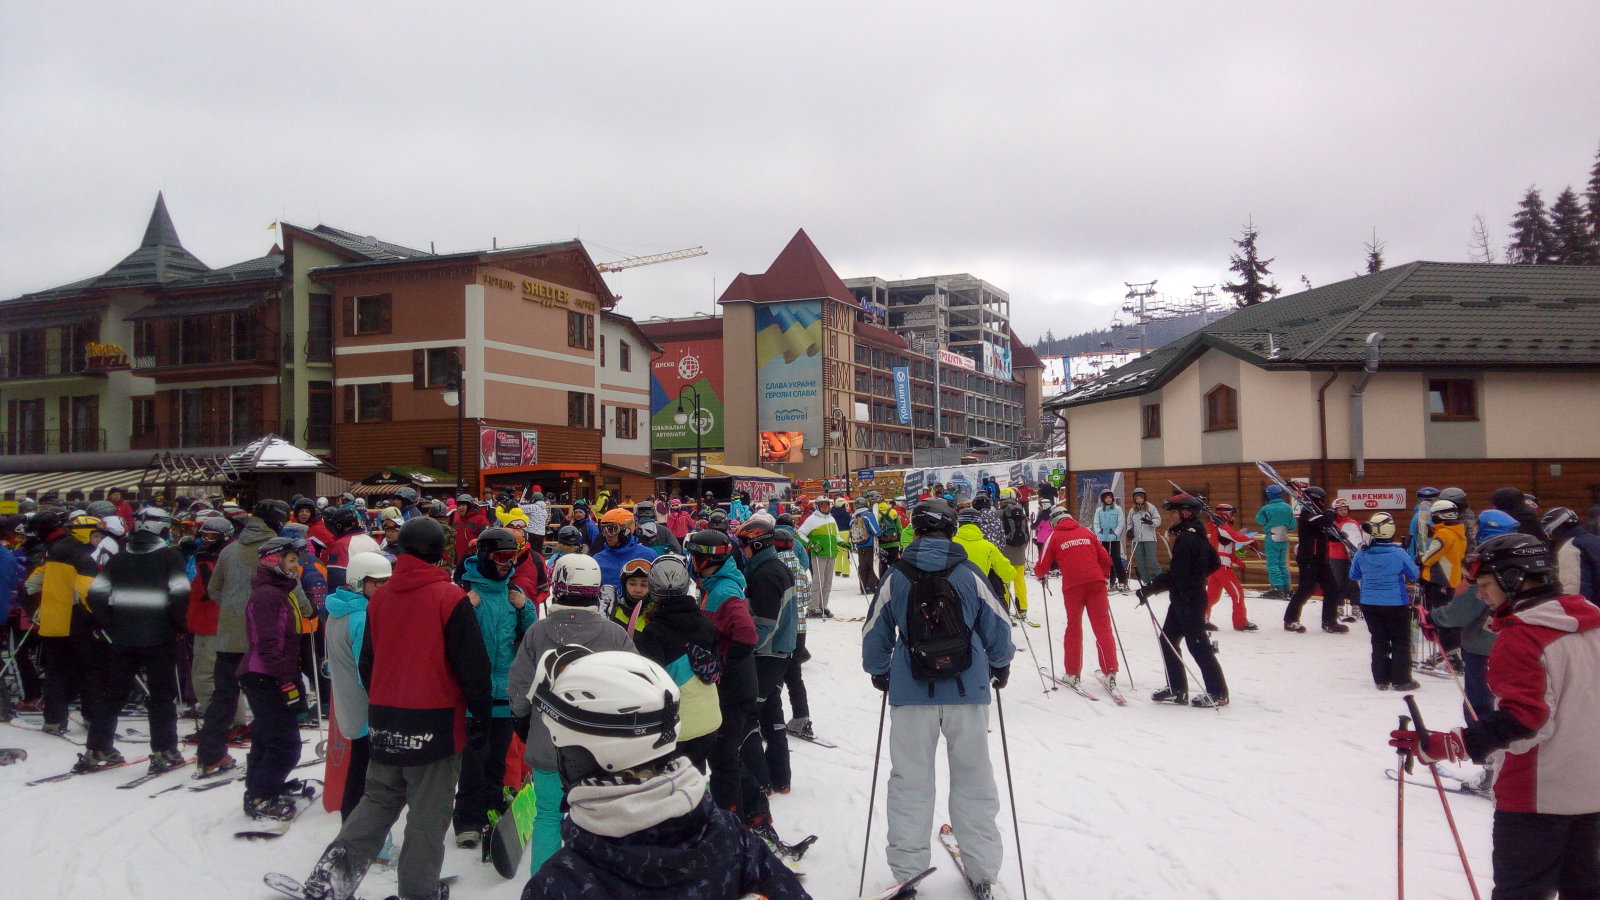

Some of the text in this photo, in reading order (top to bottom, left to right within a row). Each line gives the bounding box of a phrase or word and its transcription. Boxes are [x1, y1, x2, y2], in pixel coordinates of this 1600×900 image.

[522, 280, 569, 303] SHELTER
[765, 382, 788, 390] СЛАВА
[775, 413, 808, 422] bukovel
[1060, 538, 1091, 550] INSTRUCTOR
[540, 703, 560, 721] uvex
